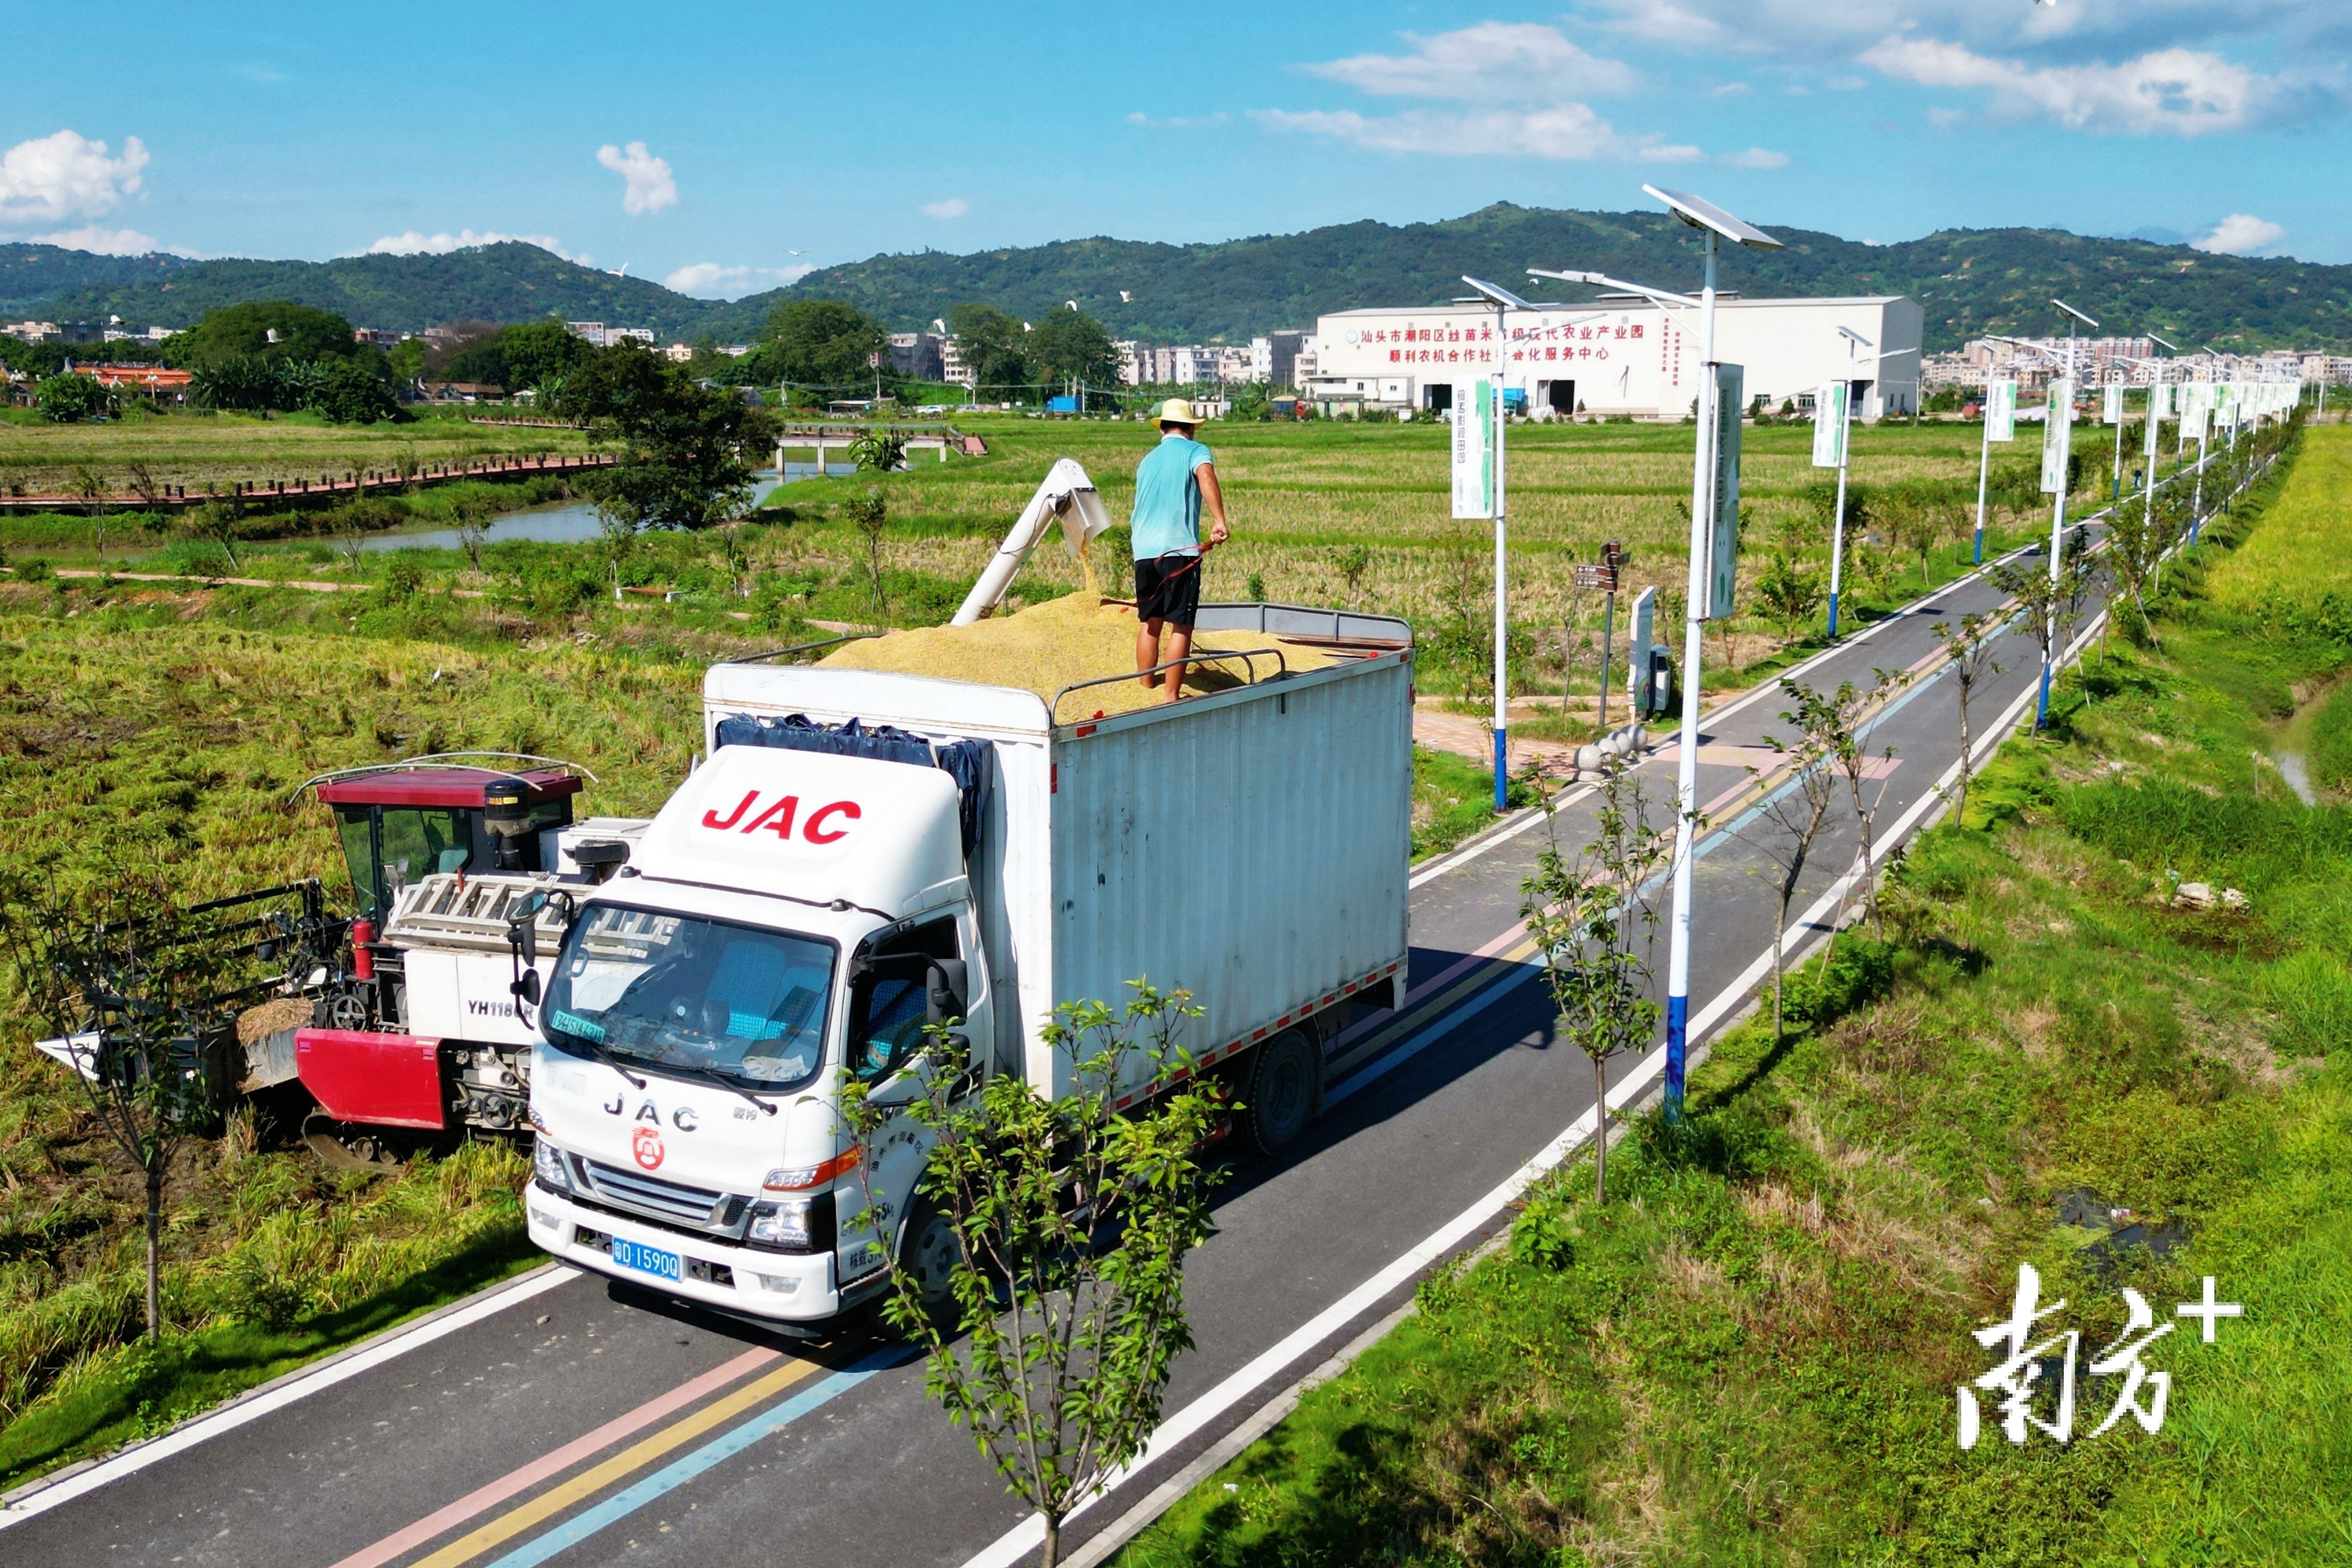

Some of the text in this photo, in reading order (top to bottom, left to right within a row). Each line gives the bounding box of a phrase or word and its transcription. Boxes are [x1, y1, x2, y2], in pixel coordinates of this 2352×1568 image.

[1390, 346, 1609, 363] 顺利农机合作社会化服务中心
[702, 789, 862, 845] JAC
[604, 1092, 698, 1132] JAC
